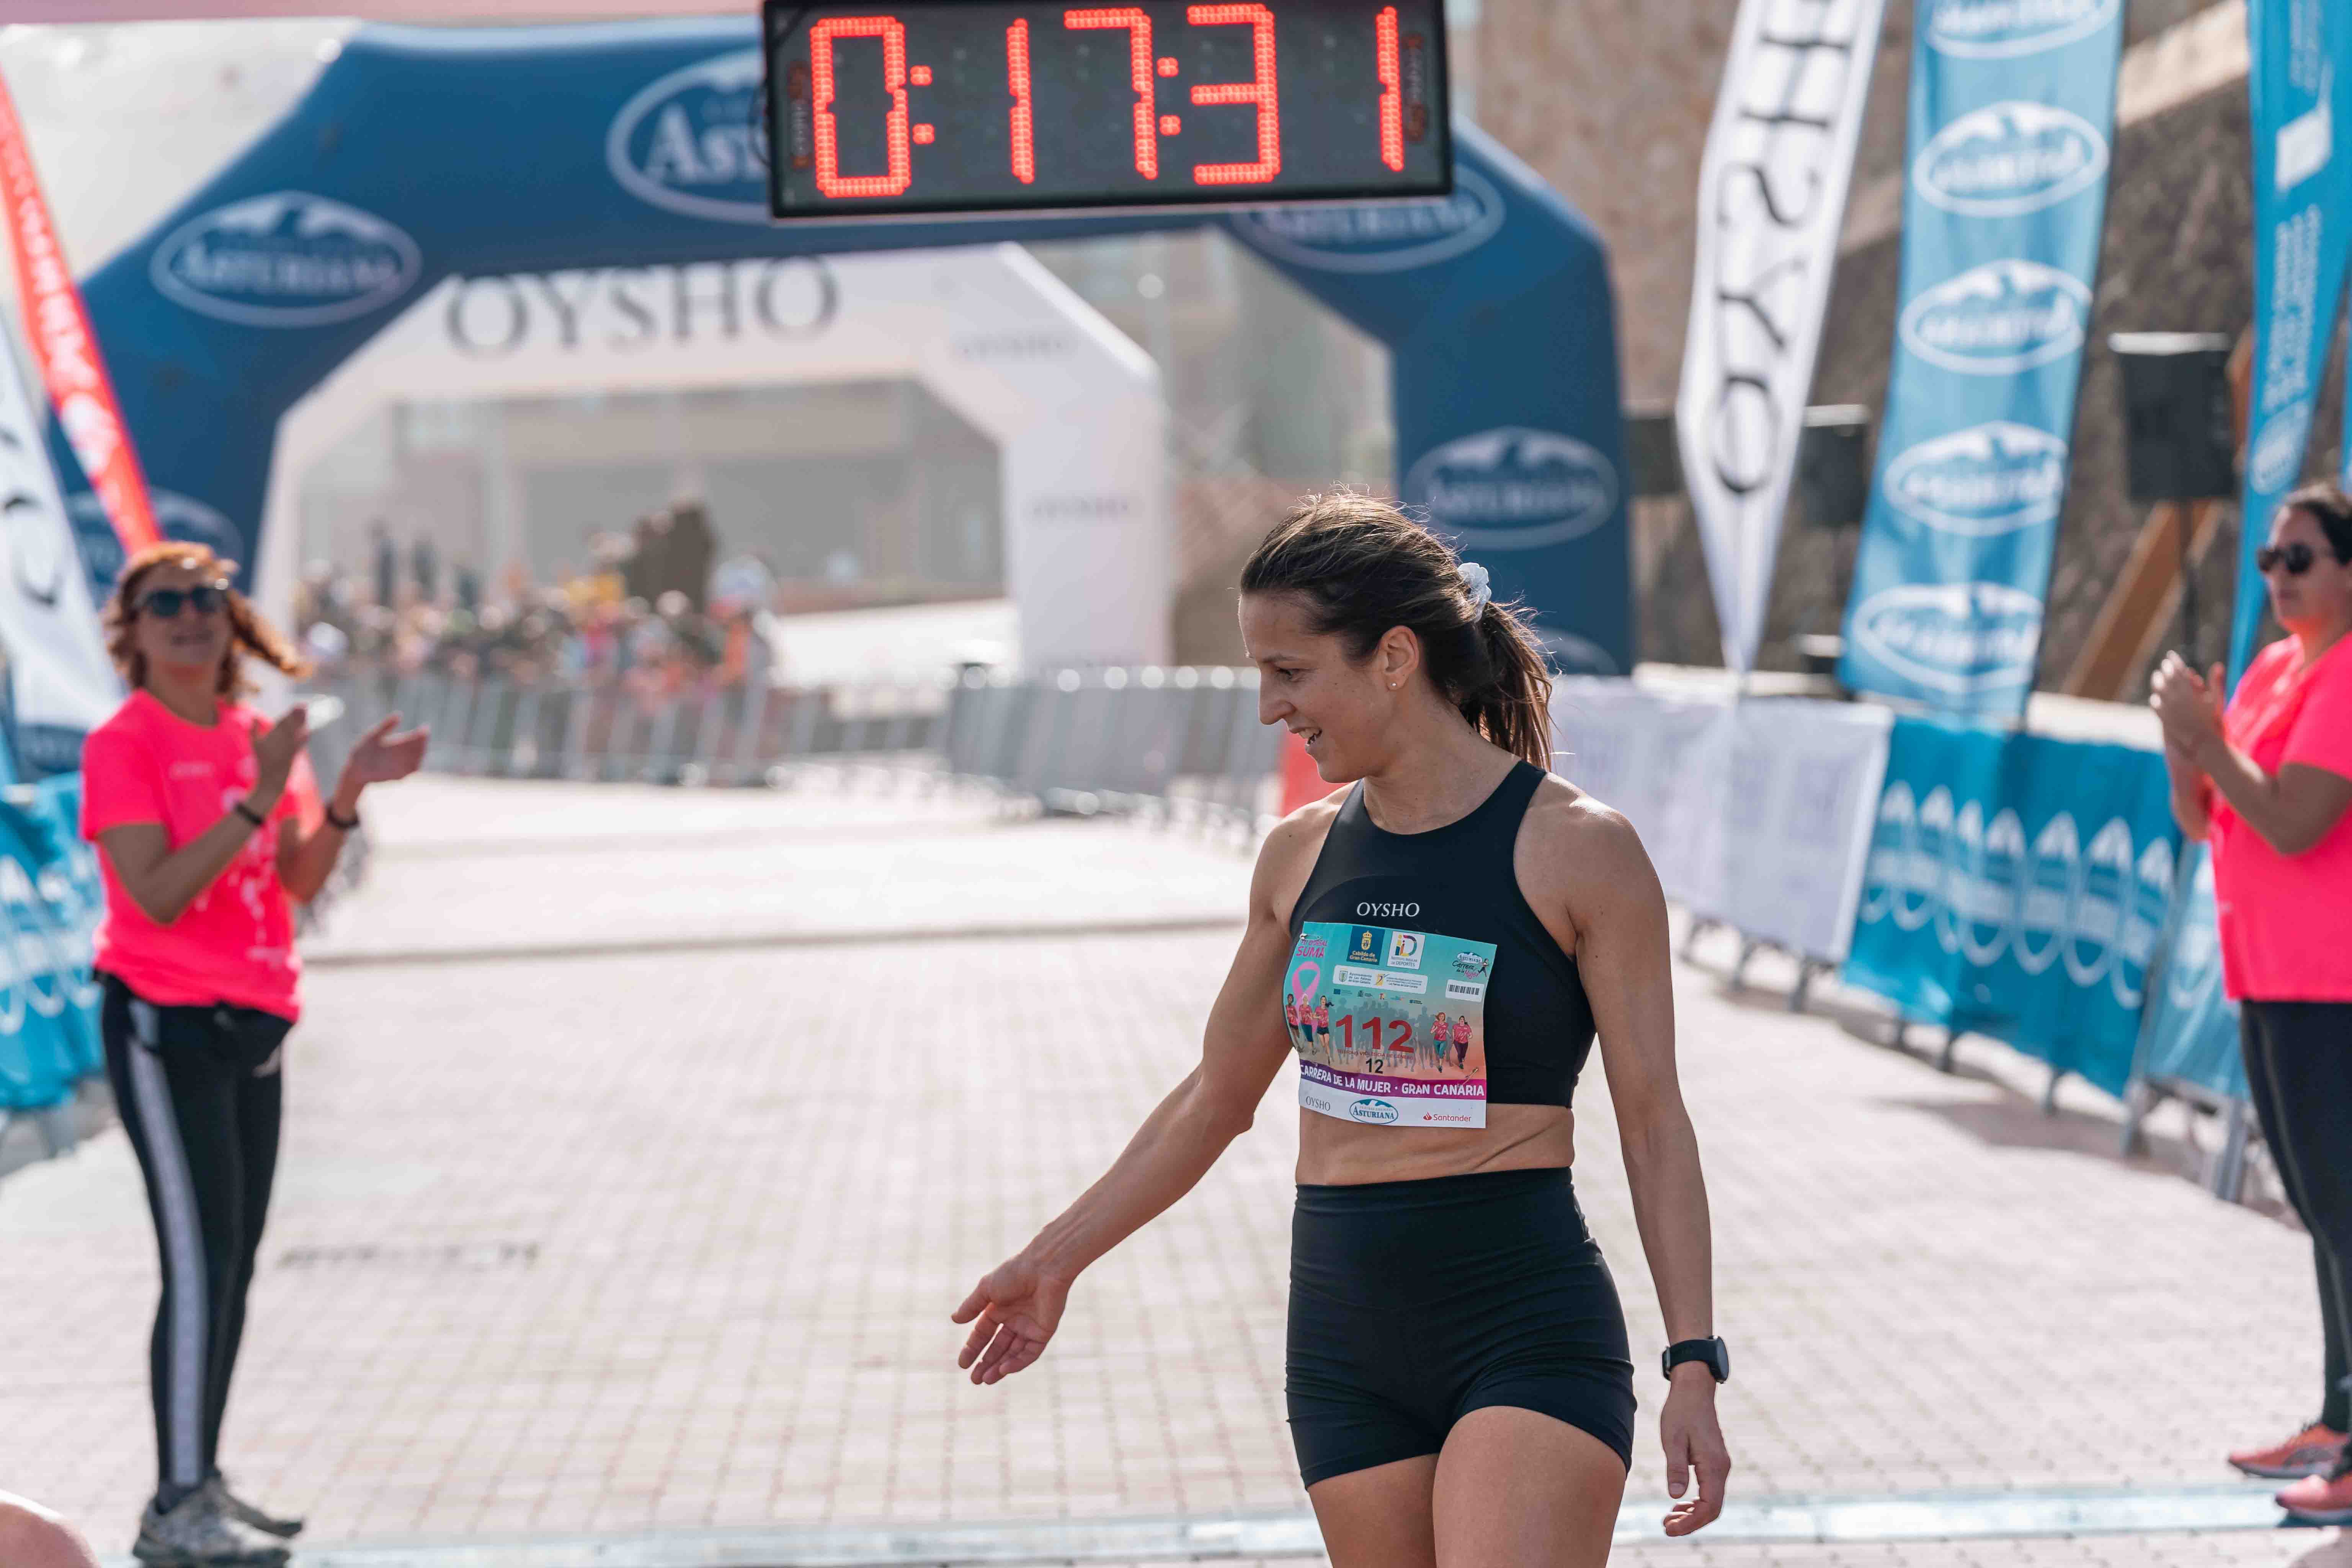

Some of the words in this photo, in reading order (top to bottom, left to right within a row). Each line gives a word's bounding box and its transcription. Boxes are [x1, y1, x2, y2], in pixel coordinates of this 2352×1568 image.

[809, 3, 1404, 198] 0:17:31
[445, 255, 838, 358] OYSHO
[1357, 902, 1420, 917] OYSHO
[1296, 946, 1324, 958] SUMA
[1452, 961, 1474, 971] Carrera
[1464, 969, 1479, 980] Mujer
[1336, 1014, 1414, 1053] 112
[1366, 1058, 1383, 1074] 12
[1333, 1073, 1343, 1086] DE
[1344, 1076, 1355, 1088] LA
[1357, 1078, 1391, 1093] MUJER
[1401, 1083, 1430, 1094] GRAN
[1434, 1084, 1485, 1096] CANARIA
[1306, 1096, 1331, 1111] OYSHO
[1353, 1105, 1395, 1119] ASTURIANA
[1433, 1114, 1471, 1122] Santander
